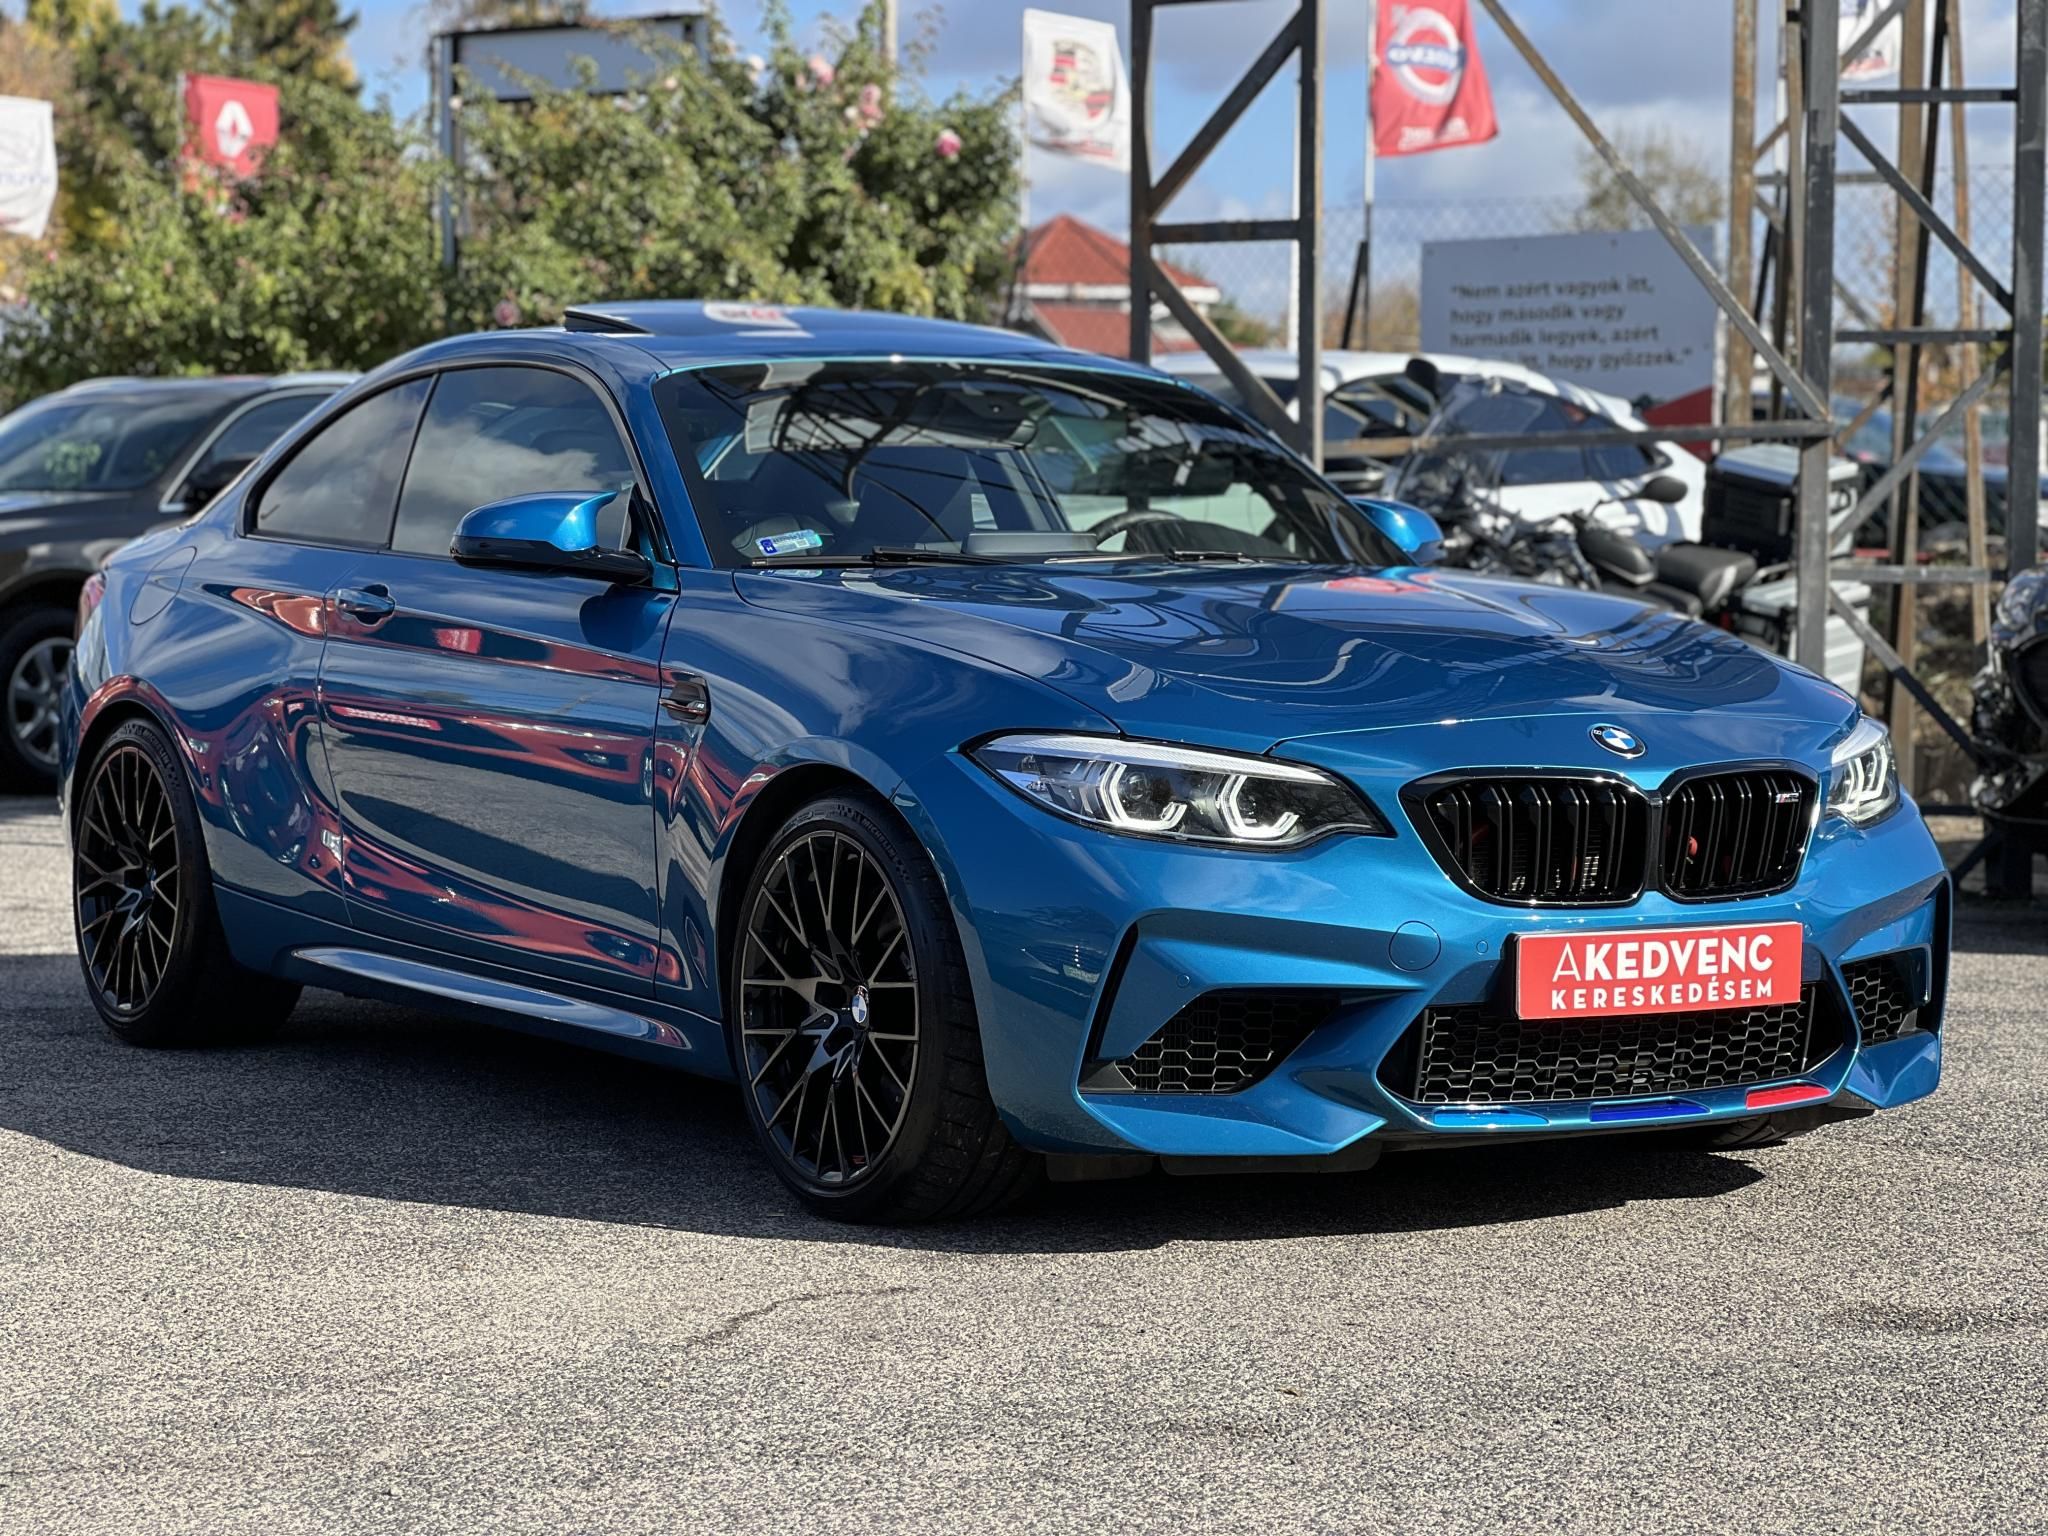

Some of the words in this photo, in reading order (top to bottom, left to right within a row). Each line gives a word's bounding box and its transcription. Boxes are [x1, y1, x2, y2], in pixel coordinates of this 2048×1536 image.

[1505, 280, 1550, 297] azért
[1554, 276, 1621, 298] vagyok
[1627, 273, 1655, 294] itt,
[1450, 308, 1493, 325] hogy
[1499, 303, 1575, 322] második
[1581, 304, 1627, 321] vagy
[1450, 329, 1532, 347] harmadik
[1539, 328, 1607, 346] legyek,
[1612, 325, 1659, 341] azért
[1548, 353, 1595, 372] hogy
[1551, 976, 1773, 1010] KERESKEDÉSEM
